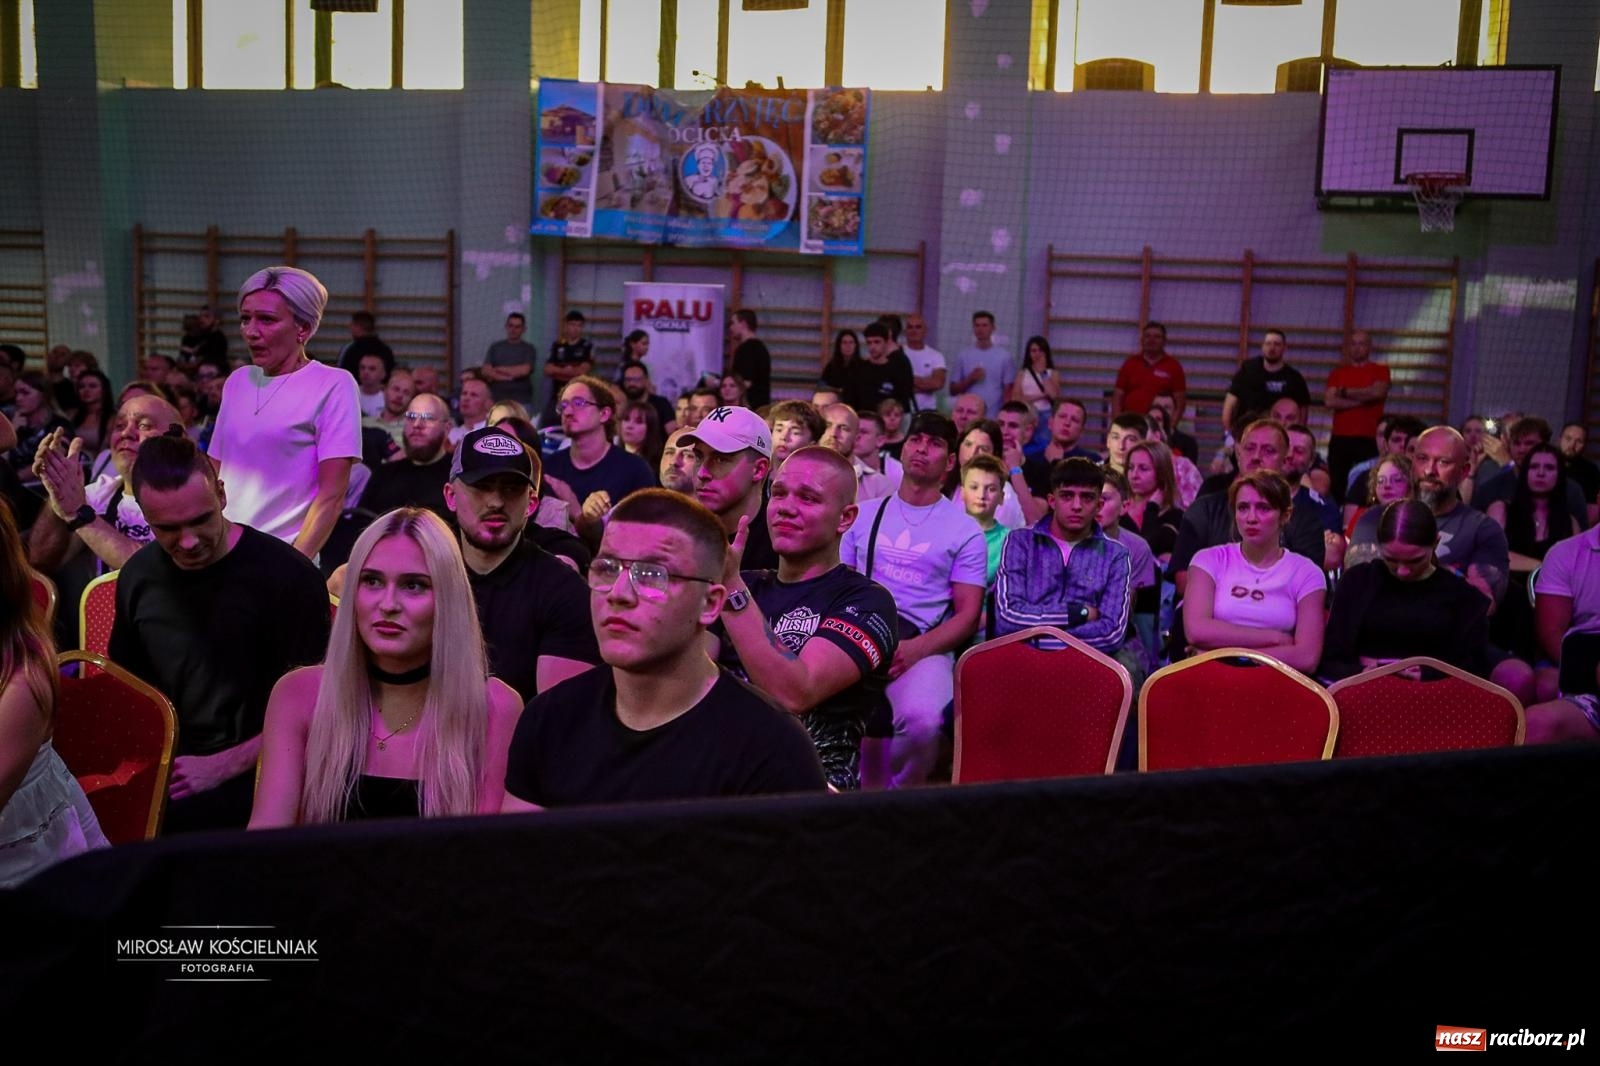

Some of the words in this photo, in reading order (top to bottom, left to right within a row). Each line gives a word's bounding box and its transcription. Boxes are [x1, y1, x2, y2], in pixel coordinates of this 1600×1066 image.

[634, 299, 712, 321] RALU
[773, 615, 821, 636] SILESIAN
[823, 619, 864, 641] RALU
